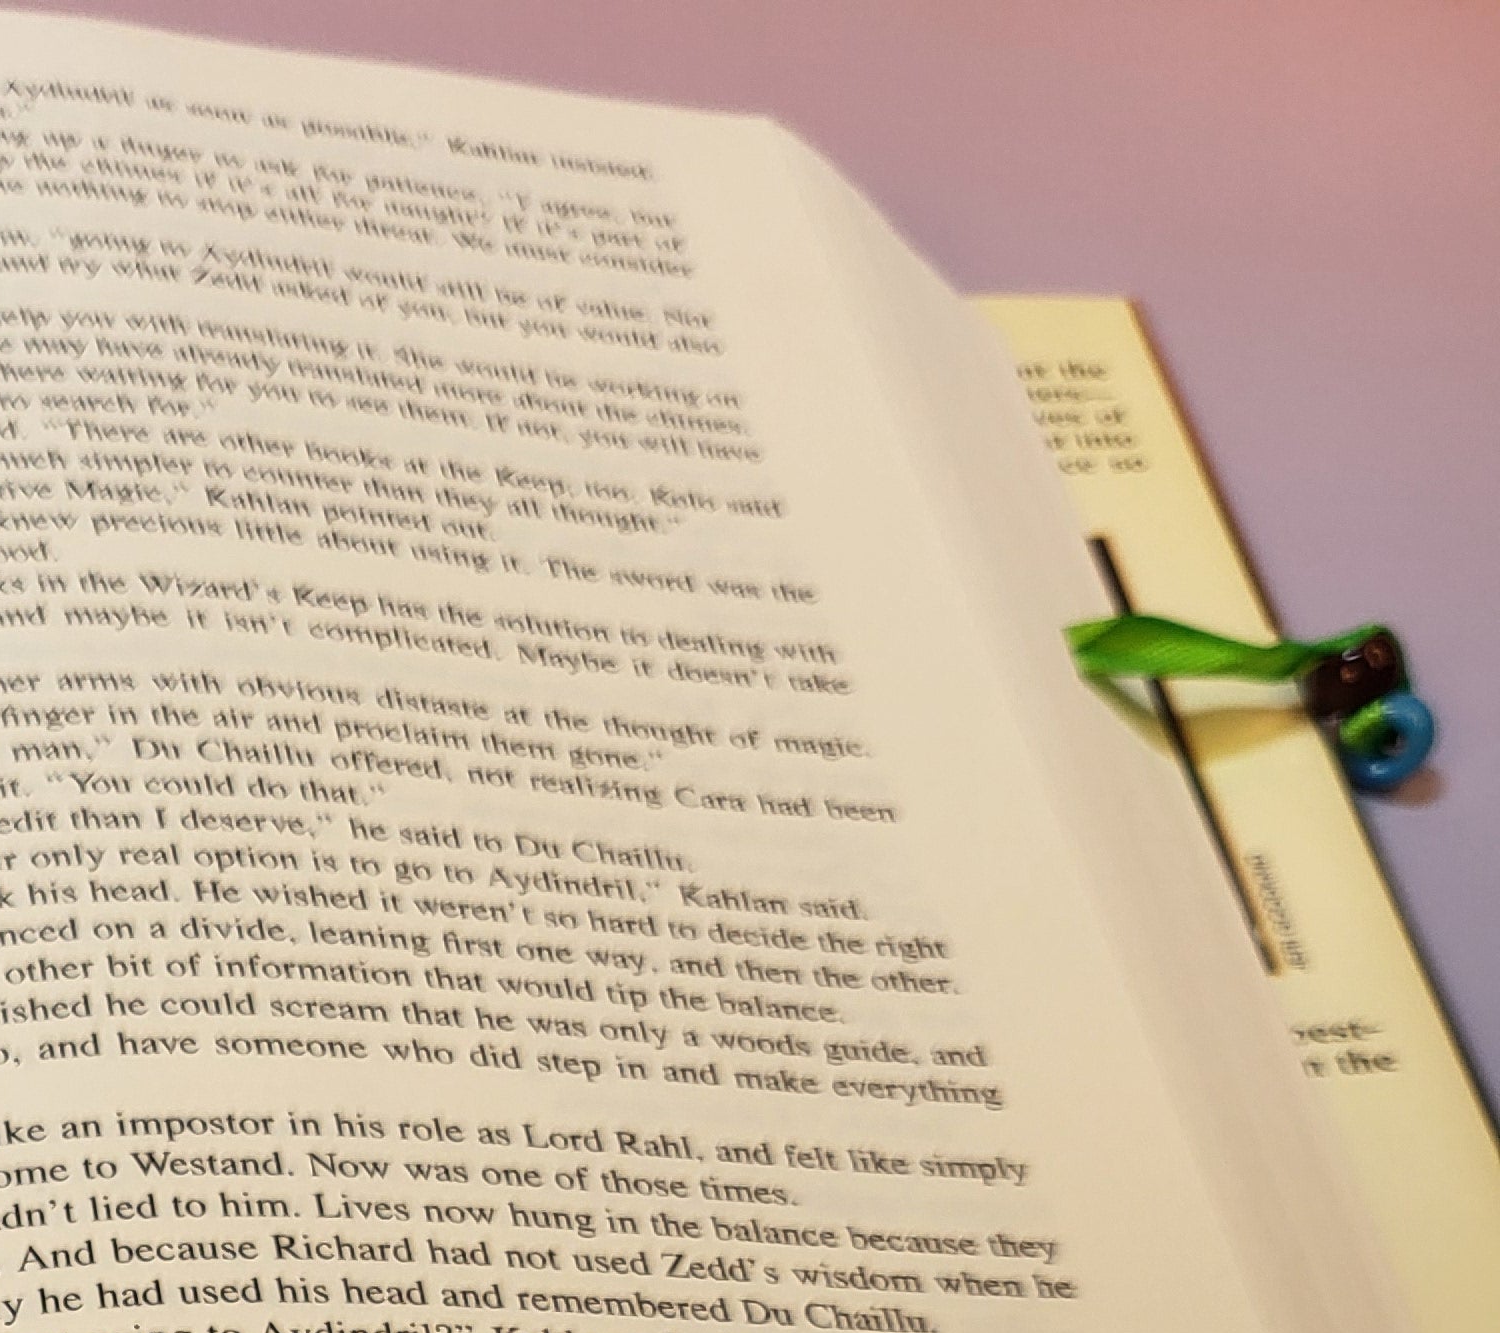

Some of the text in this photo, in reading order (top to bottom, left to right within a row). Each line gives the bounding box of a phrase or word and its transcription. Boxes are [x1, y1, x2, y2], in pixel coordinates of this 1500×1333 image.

[56, 672, 137, 692] arms
[150, 670, 223, 695] with
[236, 675, 362, 706] obvious
[375, 687, 490, 719] distaste
[503, 706, 531, 726] at
[542, 707, 590, 731] the
[601, 714, 718, 747] thought
[727, 728, 762, 751] of
[772, 735, 874, 760] magic.
[68, 806, 143, 830] than
[154, 806, 167, 830] I
[347, 816, 389, 842] he
[398, 825, 463, 850] said
[472, 832, 505, 854] to
[513, 832, 562, 860] Du
[570, 839, 694, 874] Chaillu.
[60, 1119, 103, 1141] an
[115, 1111, 276, 1143] impostor
[286, 1110, 323, 1137] in
[332, 1111, 387, 1140] his
[396, 1116, 466, 1144] role
[476, 1126, 513, 1147] as
[520, 1122, 606, 1154] Lord
[614, 1130, 706, 1163] Rahl,
[714, 1141, 776, 1167] and
[783, 1143, 841, 1172] felt
[845, 1148, 913, 1177] like
[918, 1153, 1032, 1188] simply
